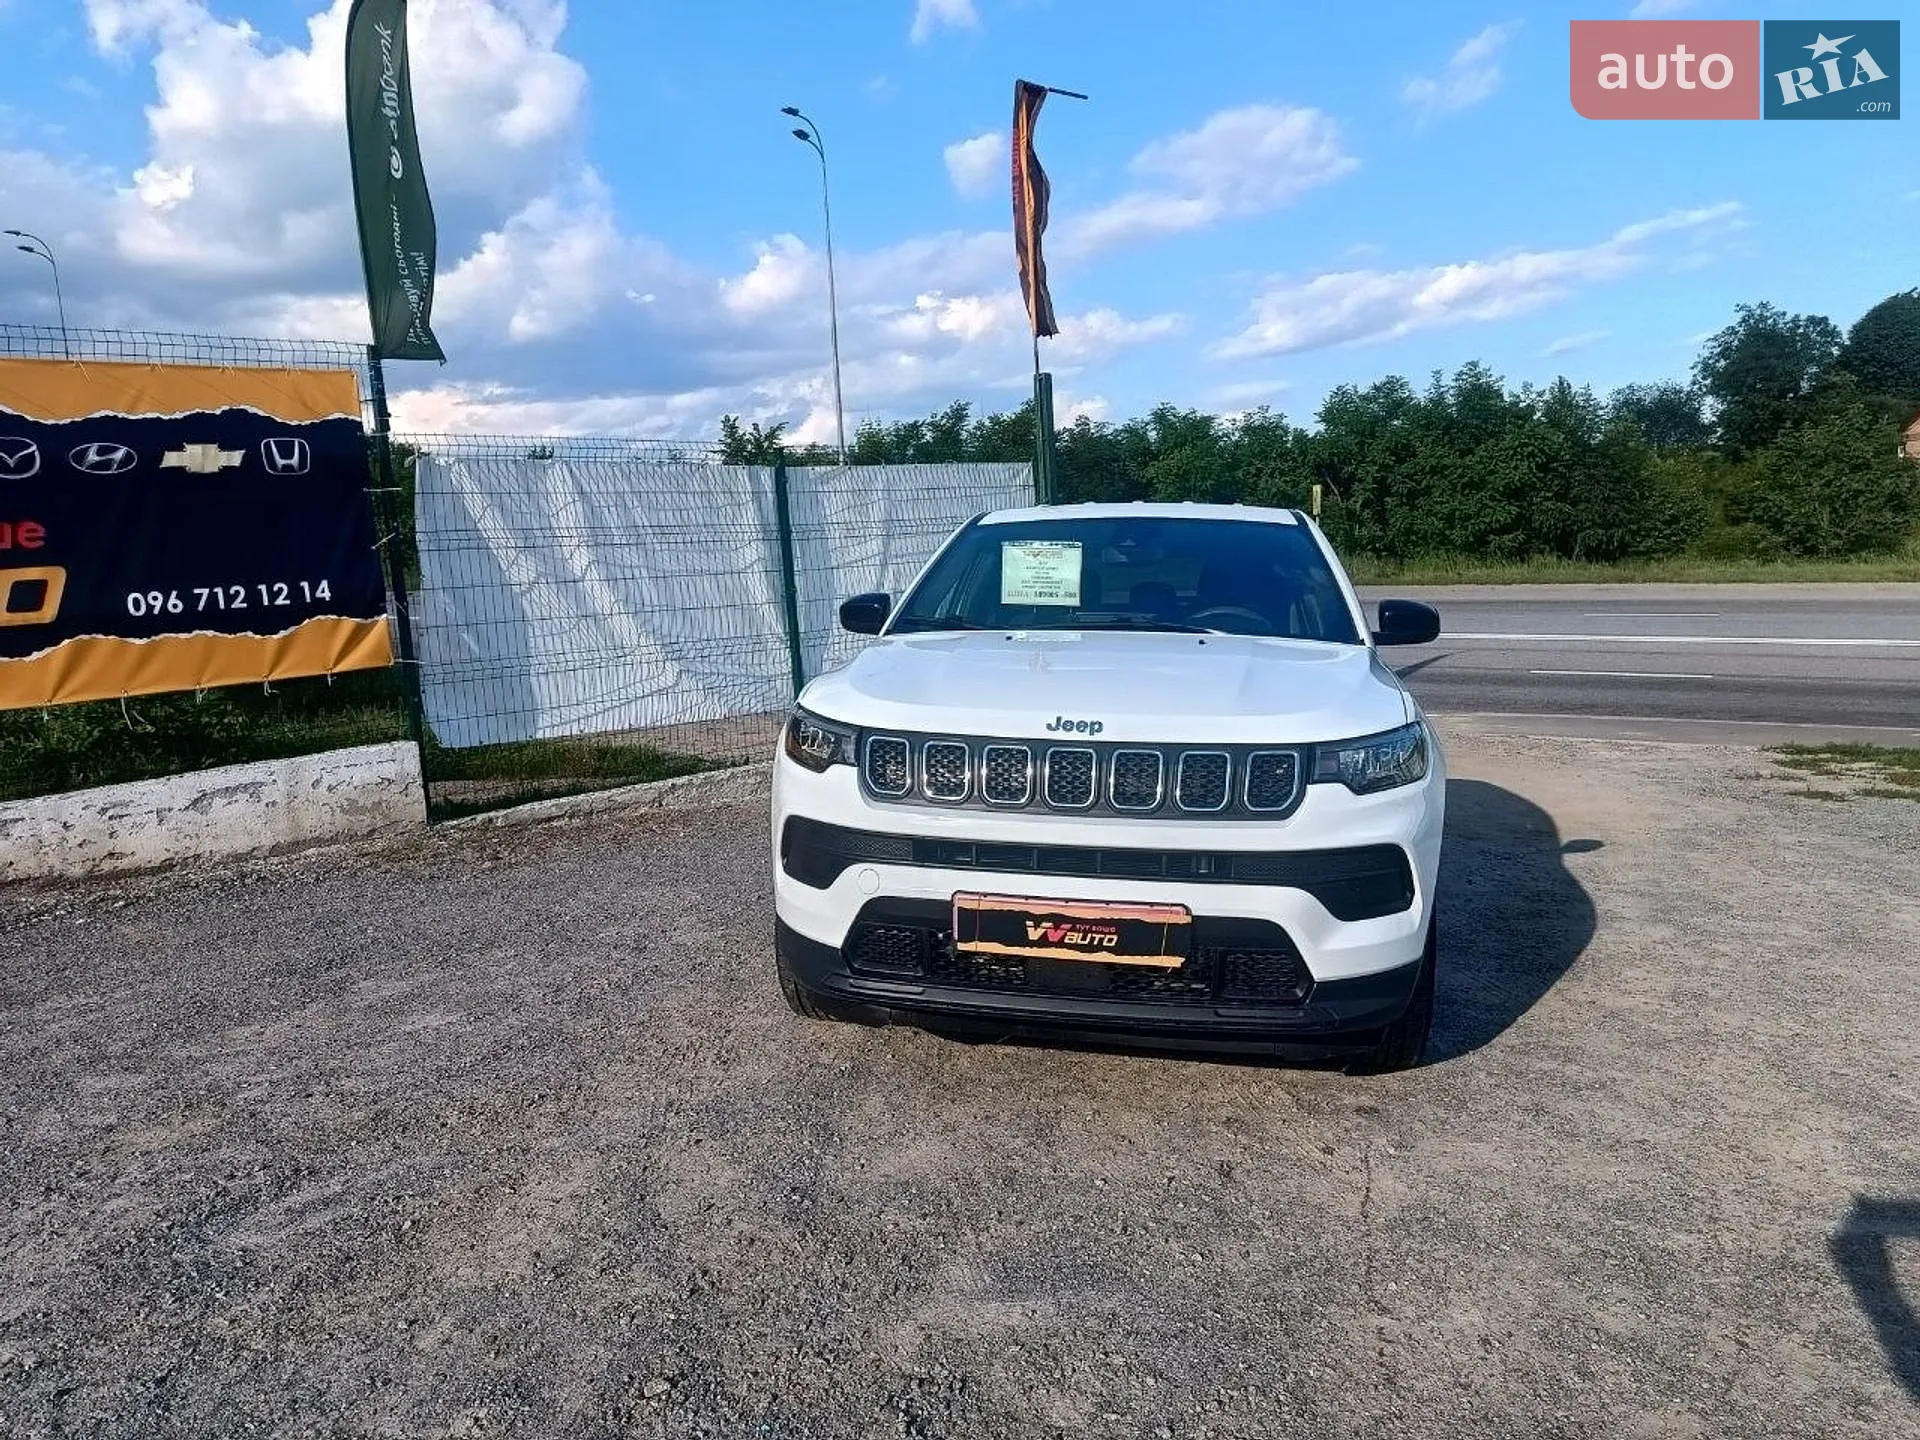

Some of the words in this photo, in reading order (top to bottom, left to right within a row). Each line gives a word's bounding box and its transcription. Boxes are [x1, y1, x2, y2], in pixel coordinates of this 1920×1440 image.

[127, 590, 184, 617] 096
[193, 585, 248, 611] 712
[257, 582, 291, 606] 12
[300, 579, 332, 603] 14
[1046, 716, 1104, 736] Jeep
